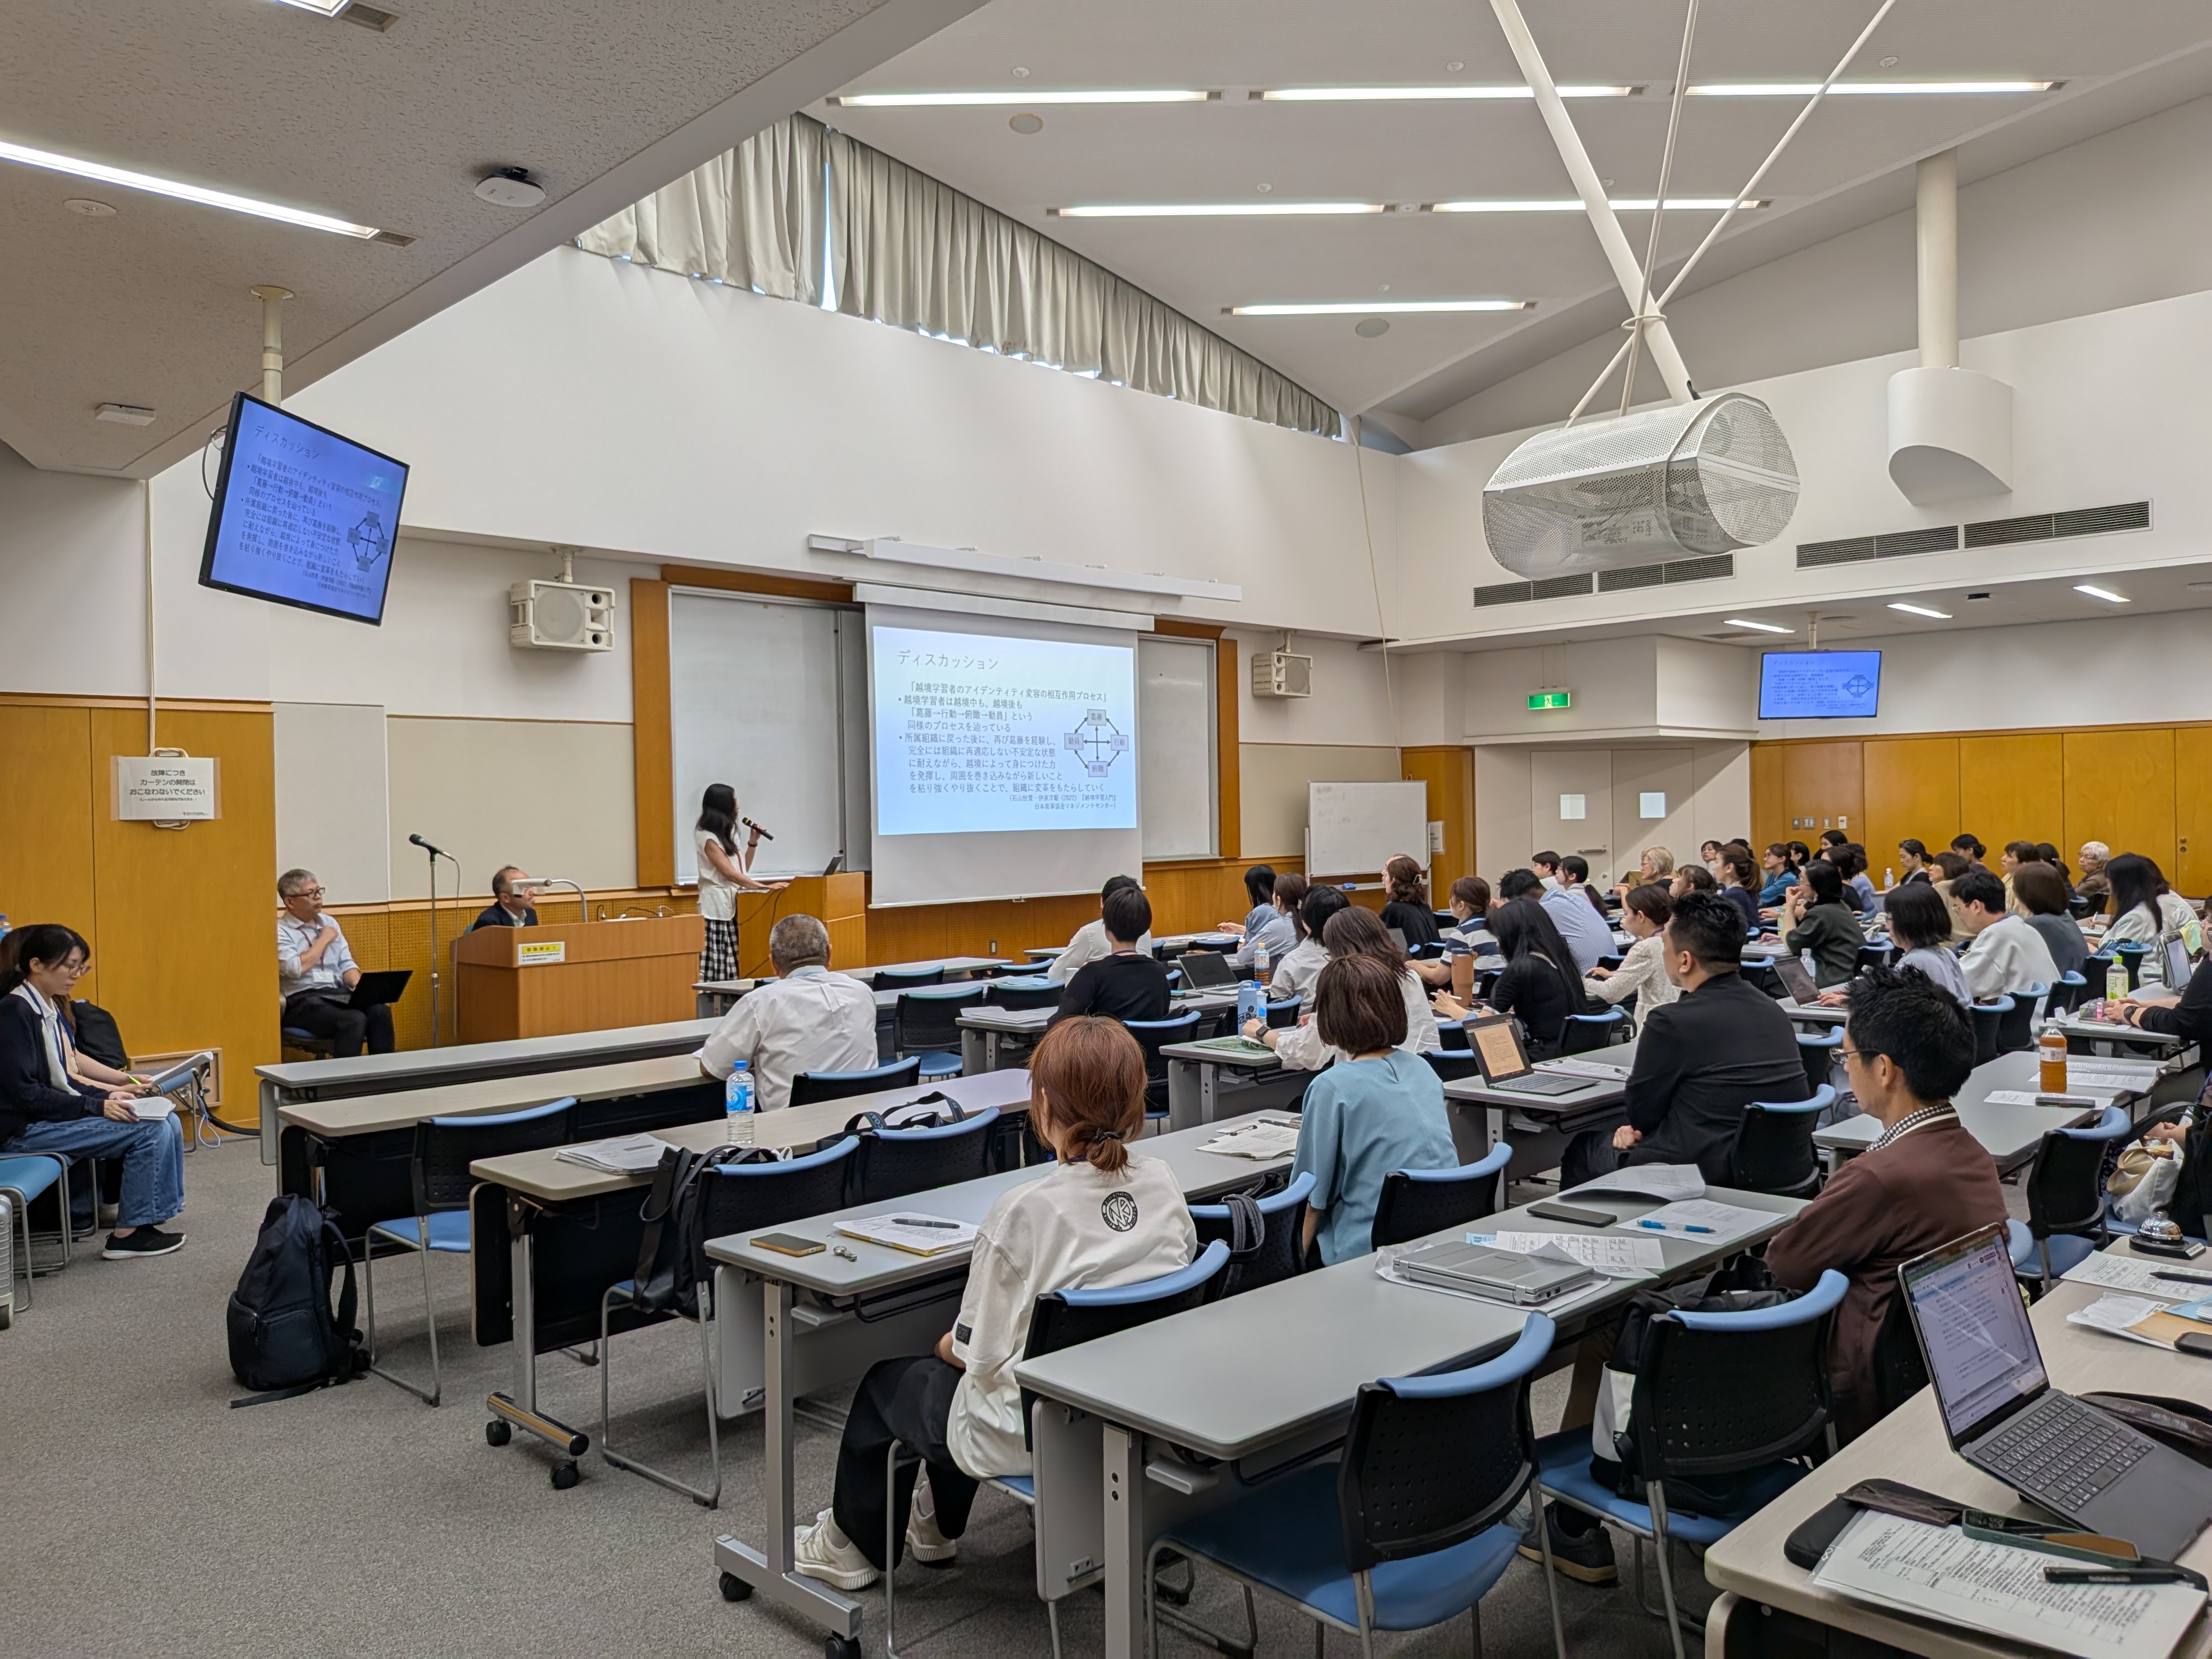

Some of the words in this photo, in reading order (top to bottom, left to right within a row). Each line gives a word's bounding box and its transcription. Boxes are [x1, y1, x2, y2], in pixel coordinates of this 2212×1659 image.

[254, 424, 320, 461] ディスカッション
[898, 650, 999, 671] ディスカッション
[1114, 738, 1125, 747] 行動
[909, 758, 1055, 769] に耐えながら、越境によって身につけた力
